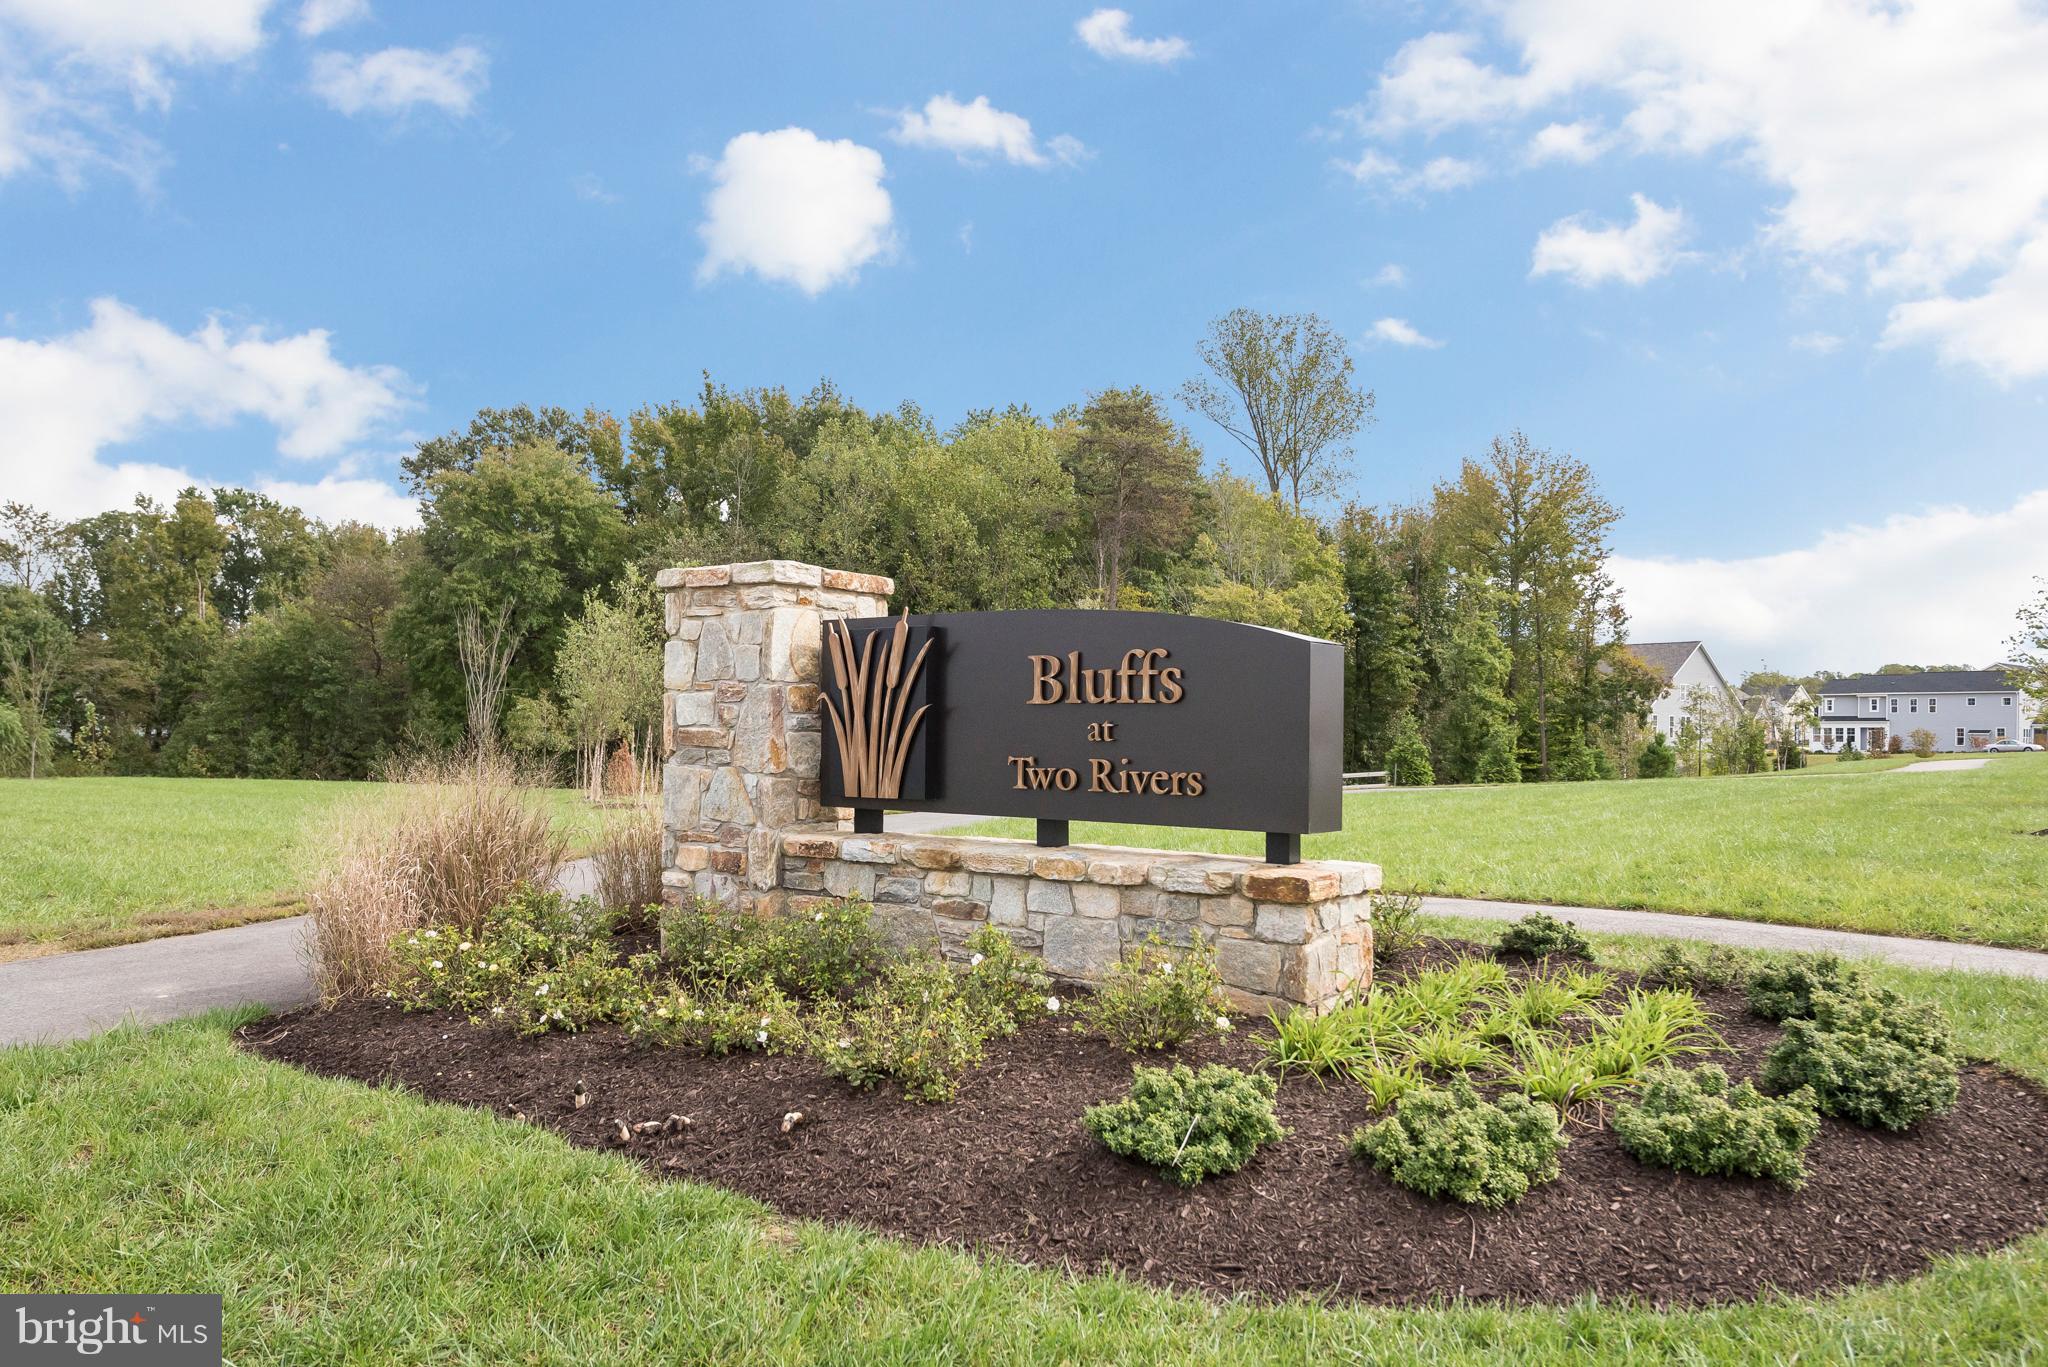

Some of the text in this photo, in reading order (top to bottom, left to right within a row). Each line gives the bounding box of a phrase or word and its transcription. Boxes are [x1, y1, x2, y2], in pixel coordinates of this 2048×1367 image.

[1025, 648, 1183, 705] Bluffs
[1087, 720, 1115, 742] at
[1008, 755, 1204, 797] Two Rivers
